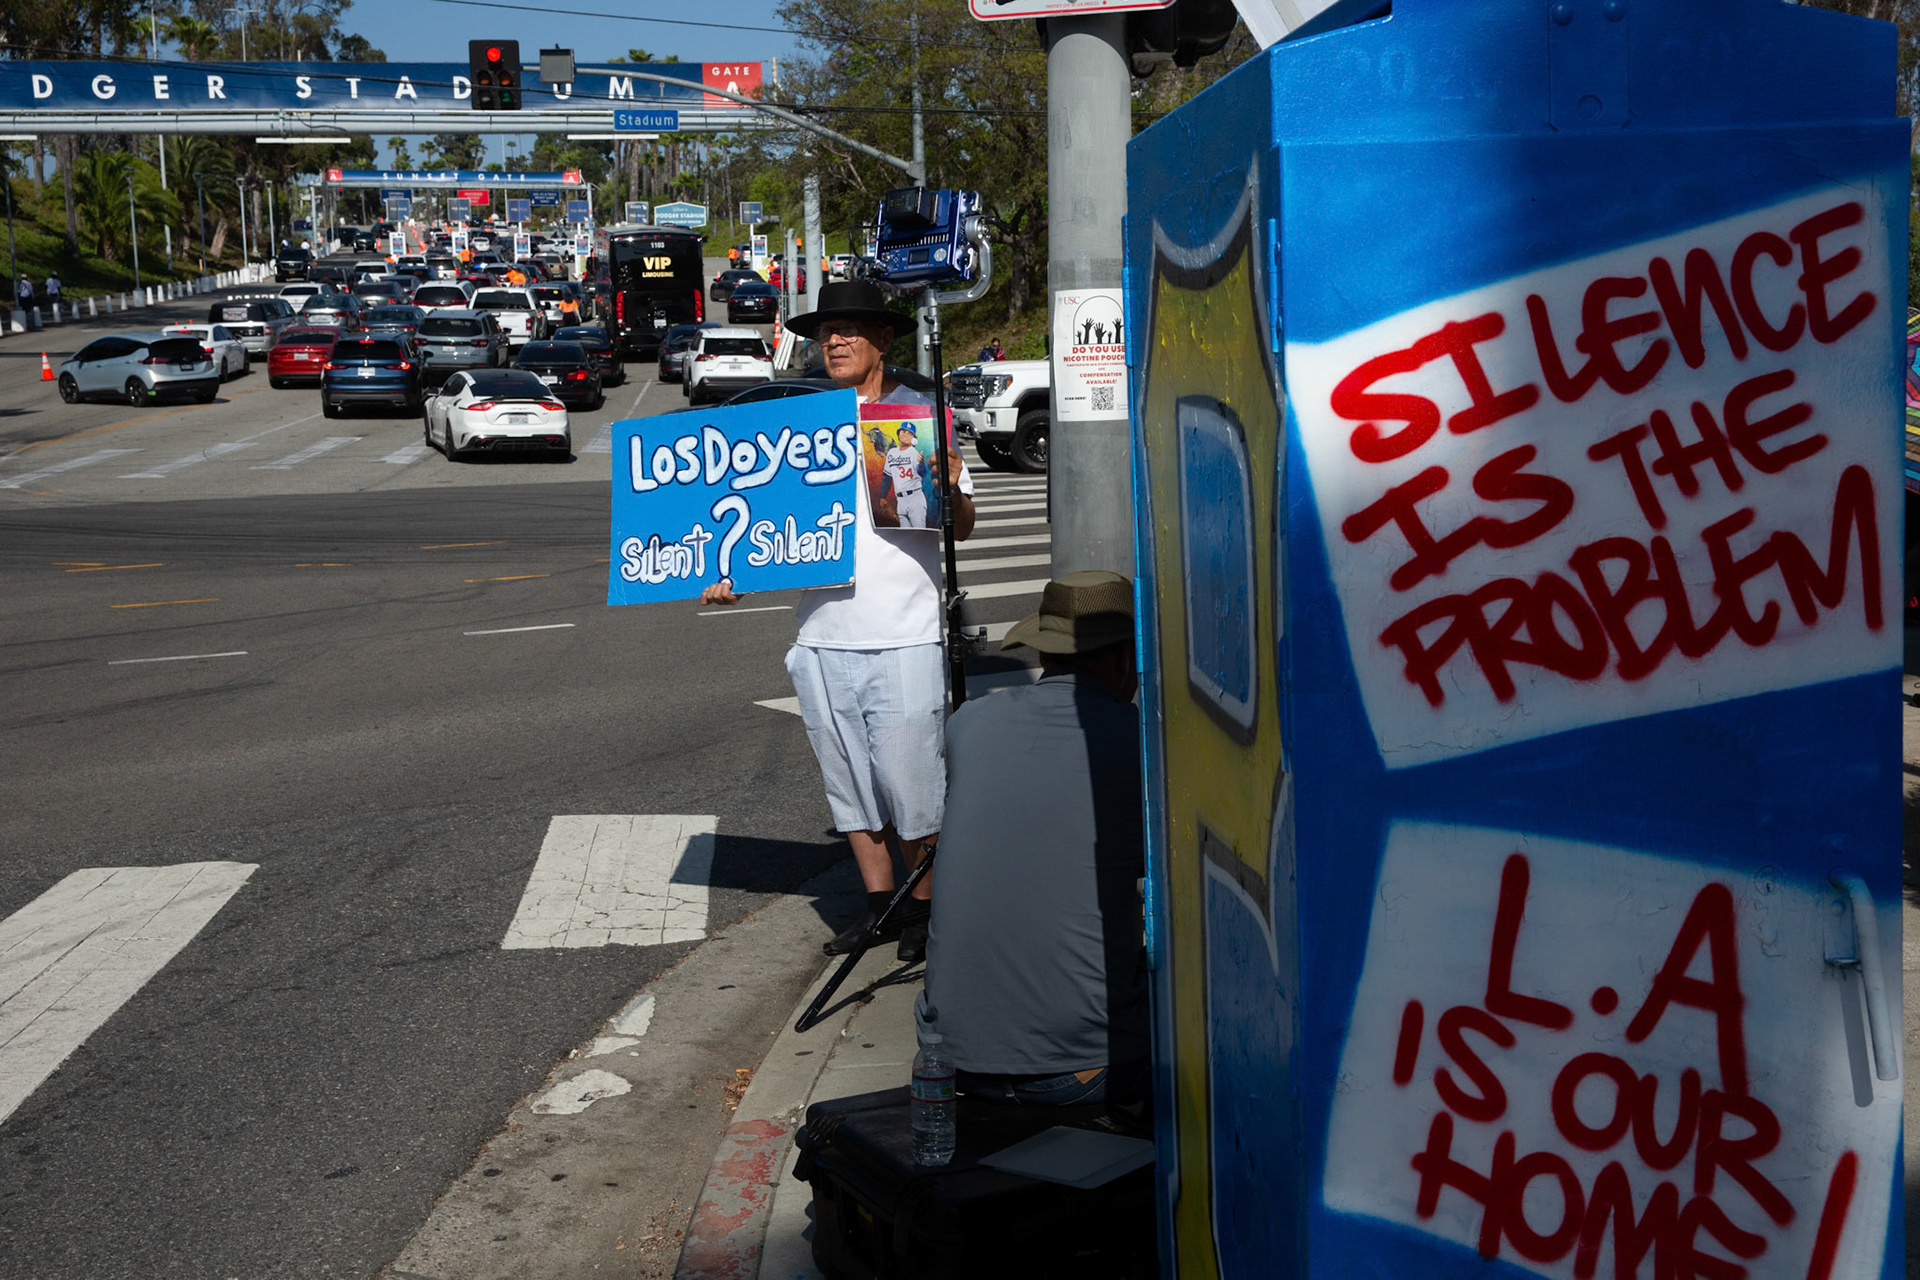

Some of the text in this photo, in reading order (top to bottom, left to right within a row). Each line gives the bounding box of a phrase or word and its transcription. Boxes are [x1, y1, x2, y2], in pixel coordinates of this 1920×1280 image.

[711, 66, 750, 76] GATE
[295, 75, 635, 100] STADUM
[618, 113, 675, 127] Stadium
[382, 172, 526, 181] SUNSET GATE
[643, 256, 672, 271] VIP
[1063, 296, 1080, 305] USC
[1330, 202, 1877, 463] SILENCE
[1072, 345, 1125, 354] DO YOU USE
[629, 433, 701, 493] Los
[898, 466, 914, 480] 34
[1341, 368, 1829, 592] IS THE
[710, 492, 751, 591] ?
[1379, 464, 1884, 708] PROBLEM
[1551, 1051, 1797, 1228] OUR
